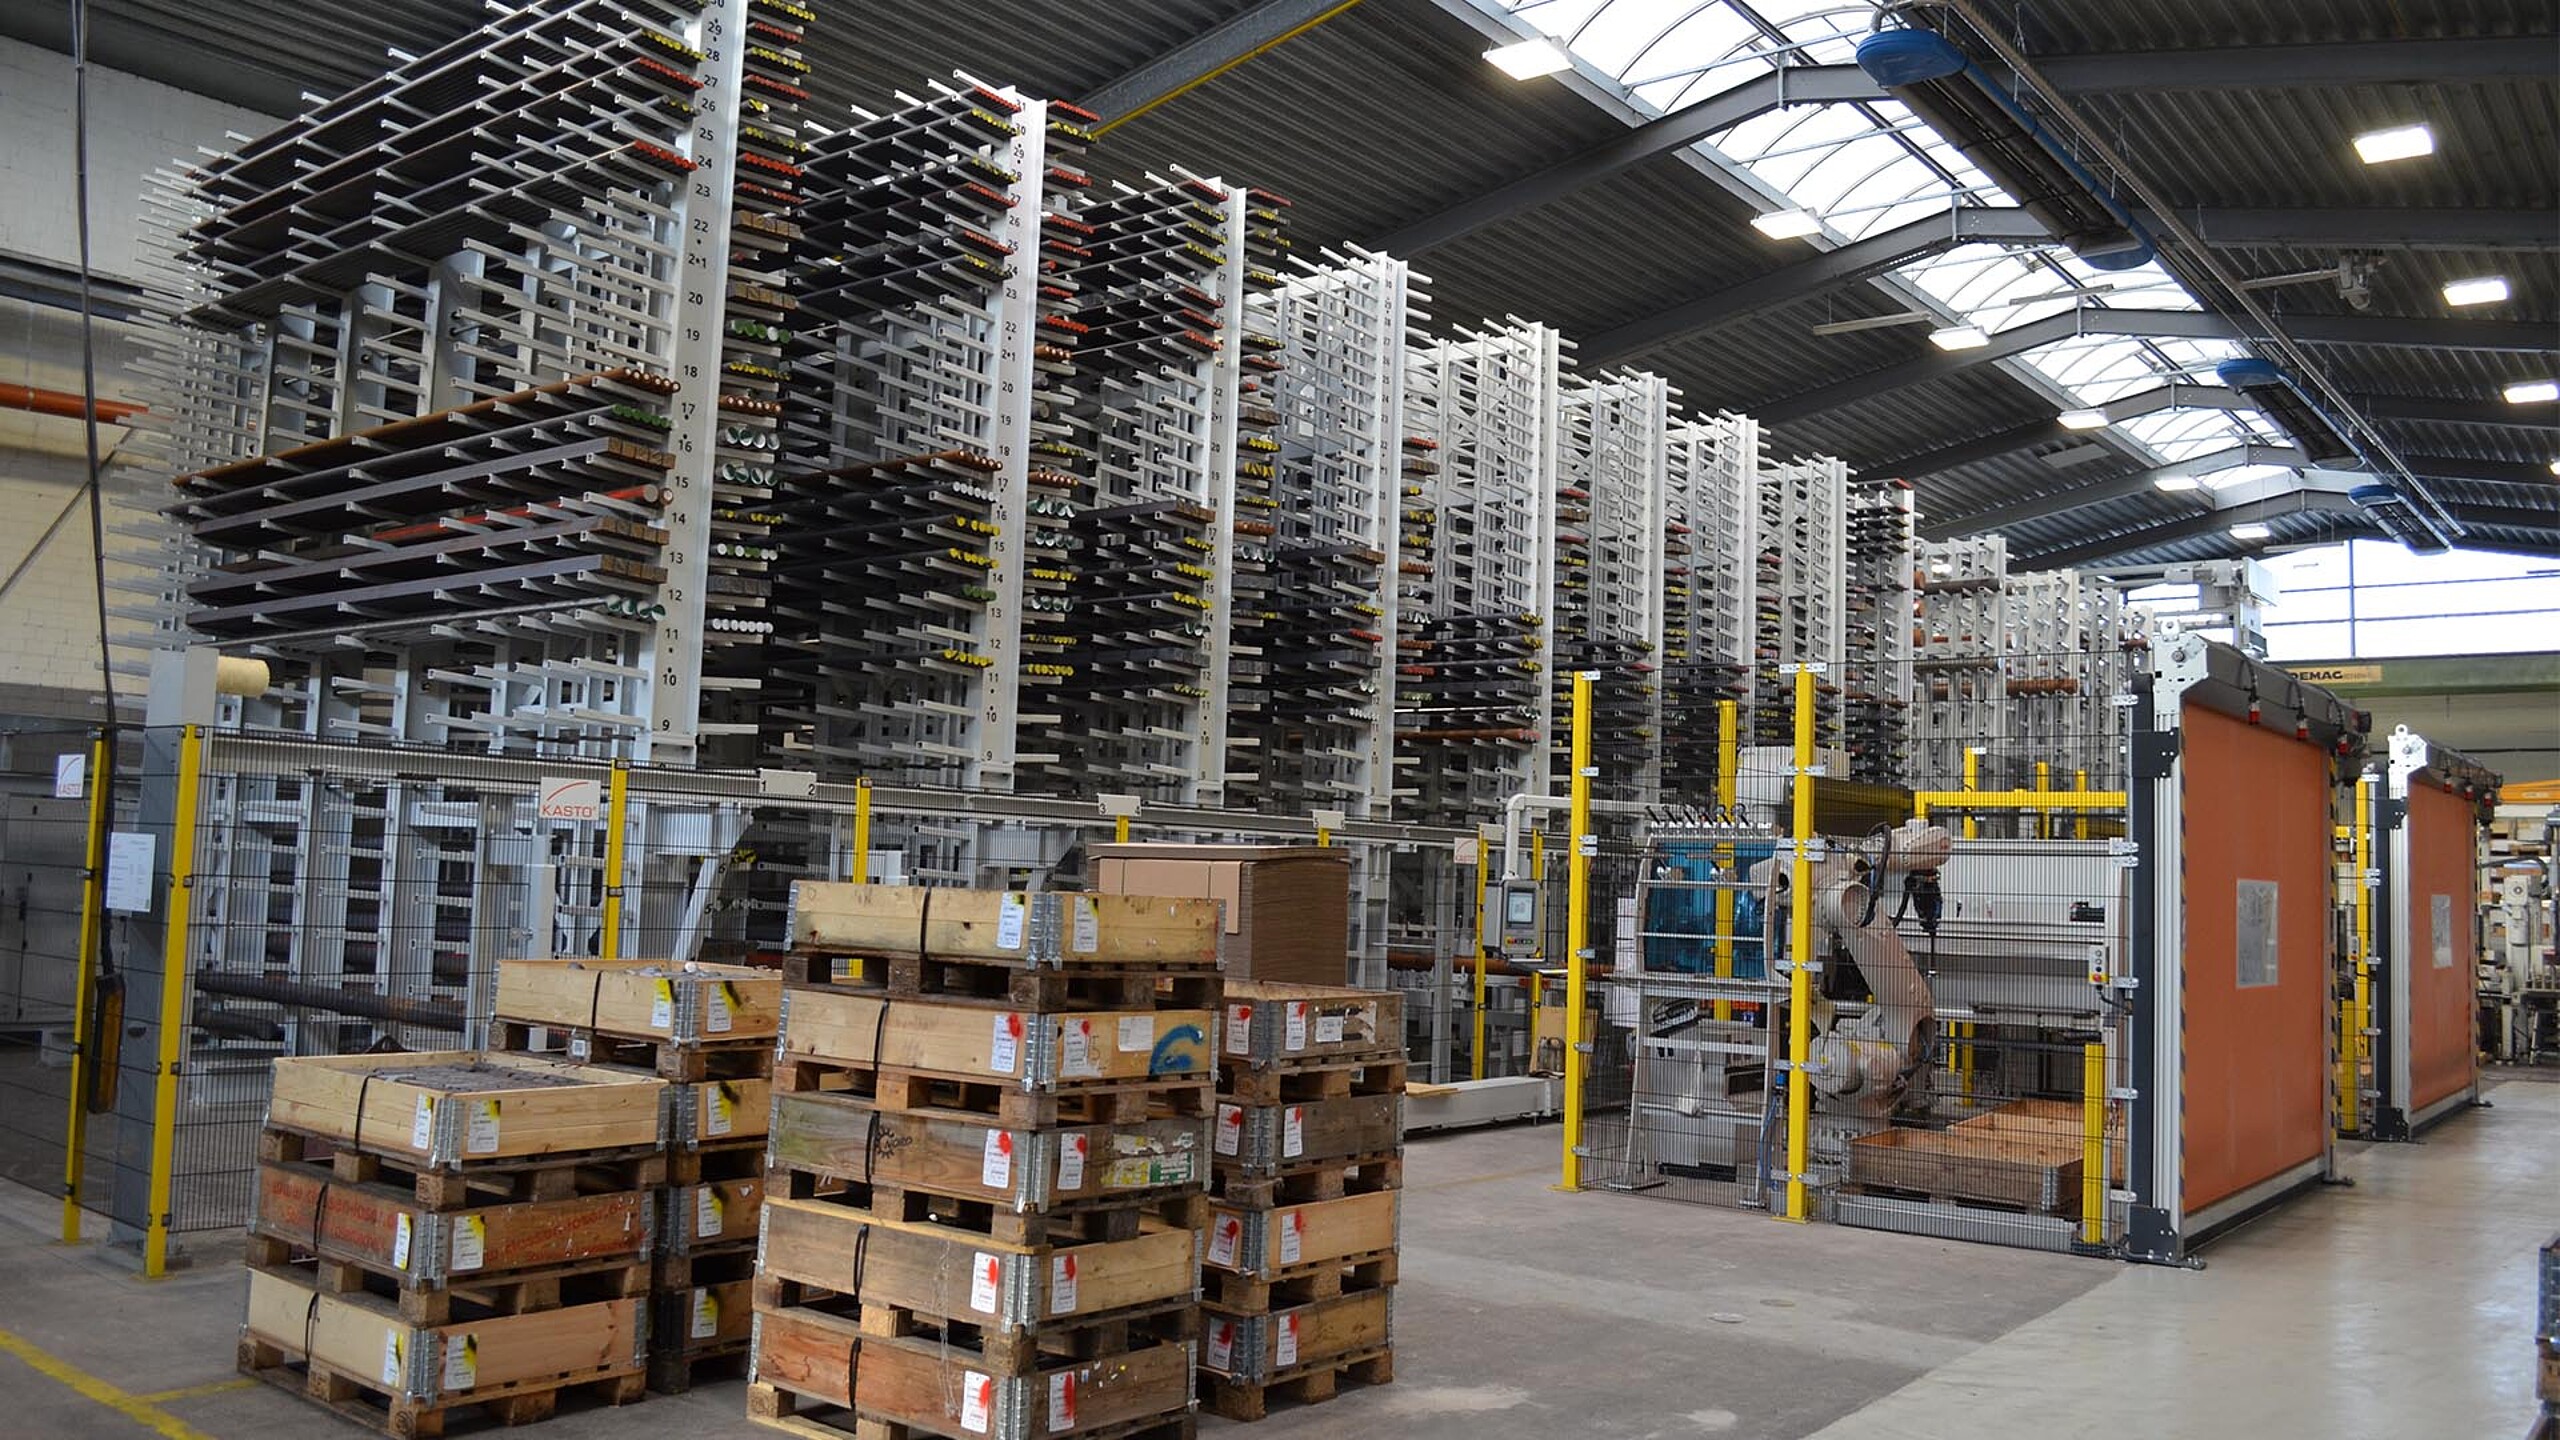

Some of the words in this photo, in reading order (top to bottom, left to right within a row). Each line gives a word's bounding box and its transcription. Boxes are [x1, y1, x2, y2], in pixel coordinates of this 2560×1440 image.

[708, 21, 722, 35] 29
[706, 48, 720, 62] 28
[704, 75, 718, 87] 27
[702, 98, 716, 112] 26
[700, 128, 714, 141] 25
[1014, 147, 1025, 159] 29
[698, 156, 712, 169] 24
[696, 184, 711, 197] 23
[1011, 193, 1021, 204] 27
[694, 219, 709, 233] 22
[1009, 216, 1020, 227] 26
[1008, 240, 1019, 251] 25
[689, 253, 707, 269] 21
[1007, 264, 1018, 276] 24
[689, 292, 703, 305] 20
[1006, 288, 1017, 299] 23
[1005, 321, 1016, 333] 22
[686, 328, 700, 341] 19
[1002, 349, 1015, 362] 21
[684, 365, 698, 378] 18
[1002, 381, 1013, 393] 20
[1213, 387, 1222, 396] 22
[682, 403, 696, 415] 17
[1001, 415, 1011, 426] 19
[679, 439, 692, 452] 16
[999, 445, 1010, 456] 18
[675, 476, 689, 489] 15
[998, 477, 1008, 488] 17
[672, 512, 686, 525] 14
[996, 510, 1007, 520] 16
[1208, 527, 1216, 537] 17
[994, 541, 1005, 552] 15
[669, 551, 684, 564] 13
[993, 573, 1003, 583] 14
[1206, 583, 1214, 593] 15
[668, 589, 682, 602] 12
[991, 608, 1001, 618] 13
[665, 628, 679, 640] 11
[990, 639, 1001, 649] 12
[663, 674, 677, 686] 10
[989, 673, 999, 682] 11
[1202, 671, 1210, 680] 12
[986, 712, 997, 722] 10
[662, 719, 670, 731] 9
[986, 751, 993, 761] 9
[761, 780, 767, 791] 1
[808, 783, 816, 795] 2
[541, 805, 592, 818] KASTO
[1100, 803, 1106, 814] 3
